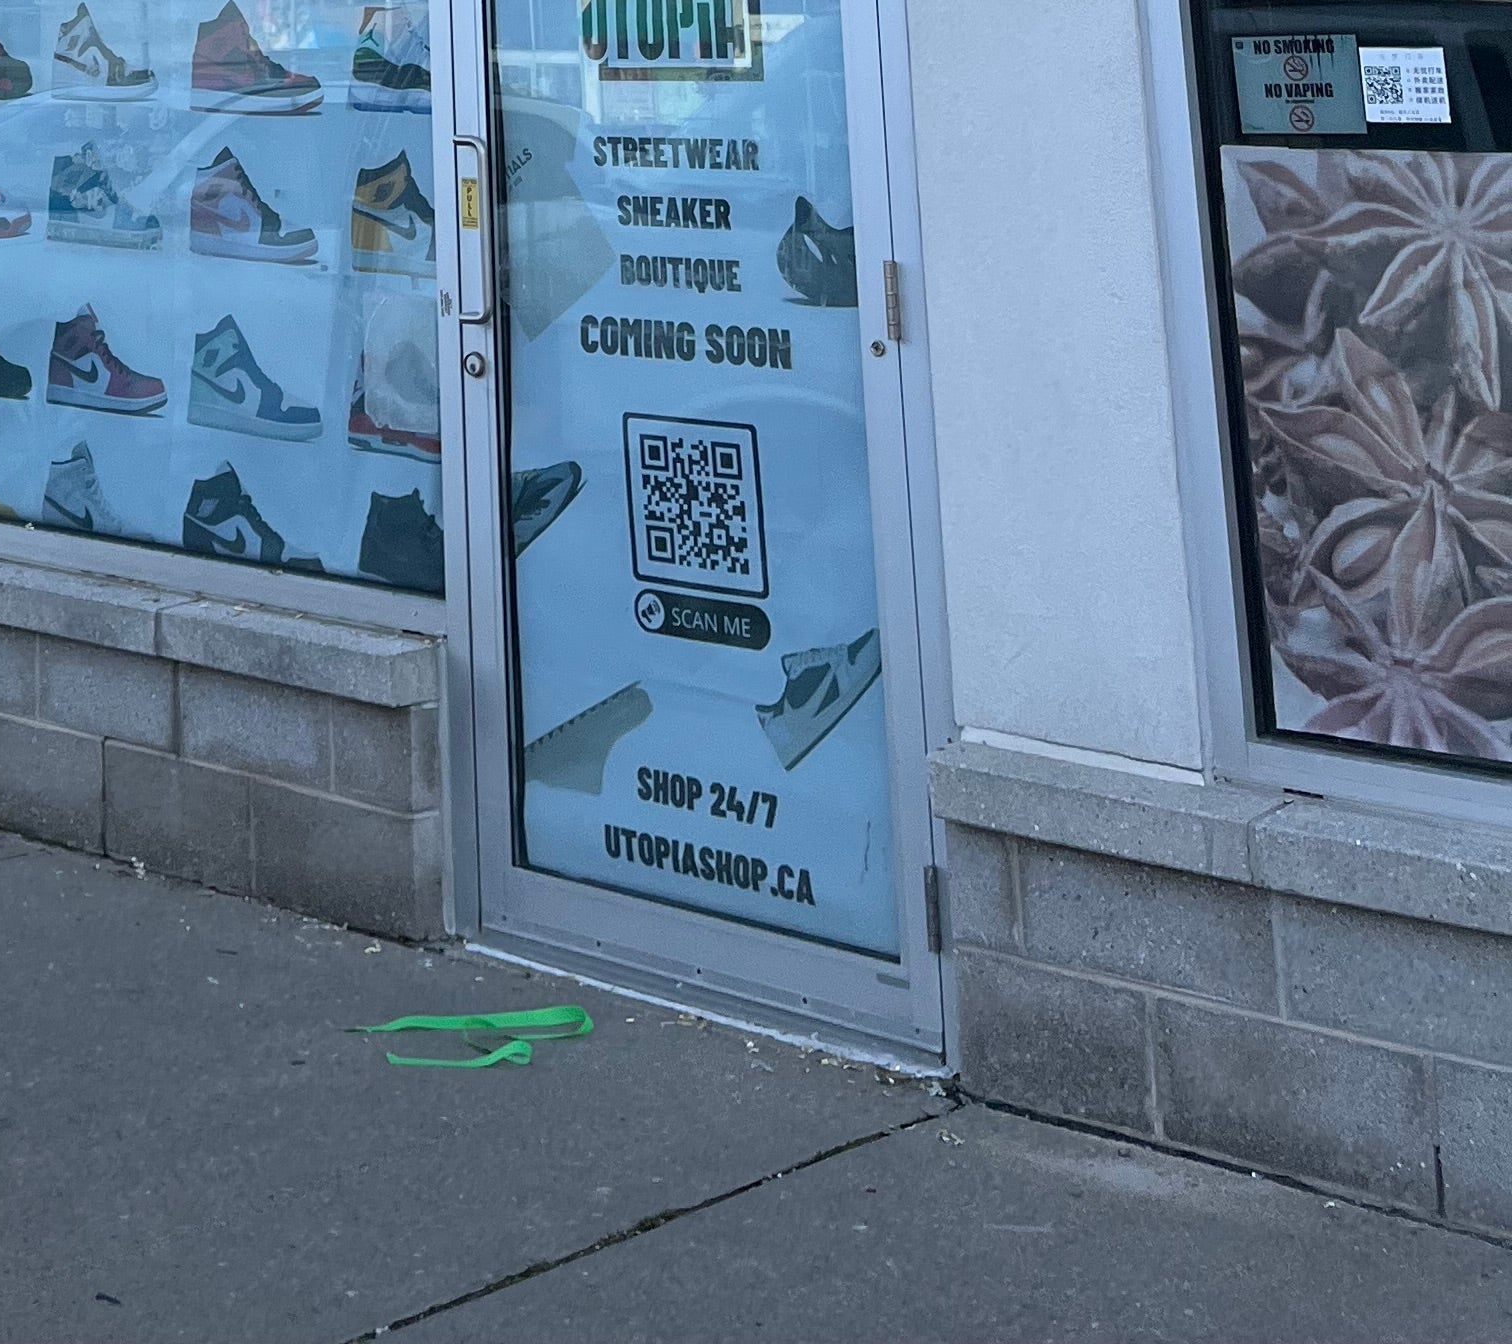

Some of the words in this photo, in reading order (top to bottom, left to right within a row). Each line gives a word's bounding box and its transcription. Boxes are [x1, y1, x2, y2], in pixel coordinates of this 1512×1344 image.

[1253, 40, 1271, 55] NO
[1273, 38, 1335, 55] SMOKING
[1264, 83, 1283, 98] NO
[1285, 82, 1334, 98] VAPING
[506, 148, 533, 180] IALS
[592, 136, 760, 172] STREETWEAR
[617, 195, 732, 231] SNEAKER
[620, 254, 743, 294] BOUTIQUE
[579, 314, 696, 362] COMING
[705, 324, 793, 370] SOON
[670, 606, 719, 635] SCAN
[723, 615, 752, 640] ME
[636, 766, 703, 811] SHOP
[709, 782, 778, 829] 24/7
[604, 823, 816, 907] UTOPIASHOP.CA
